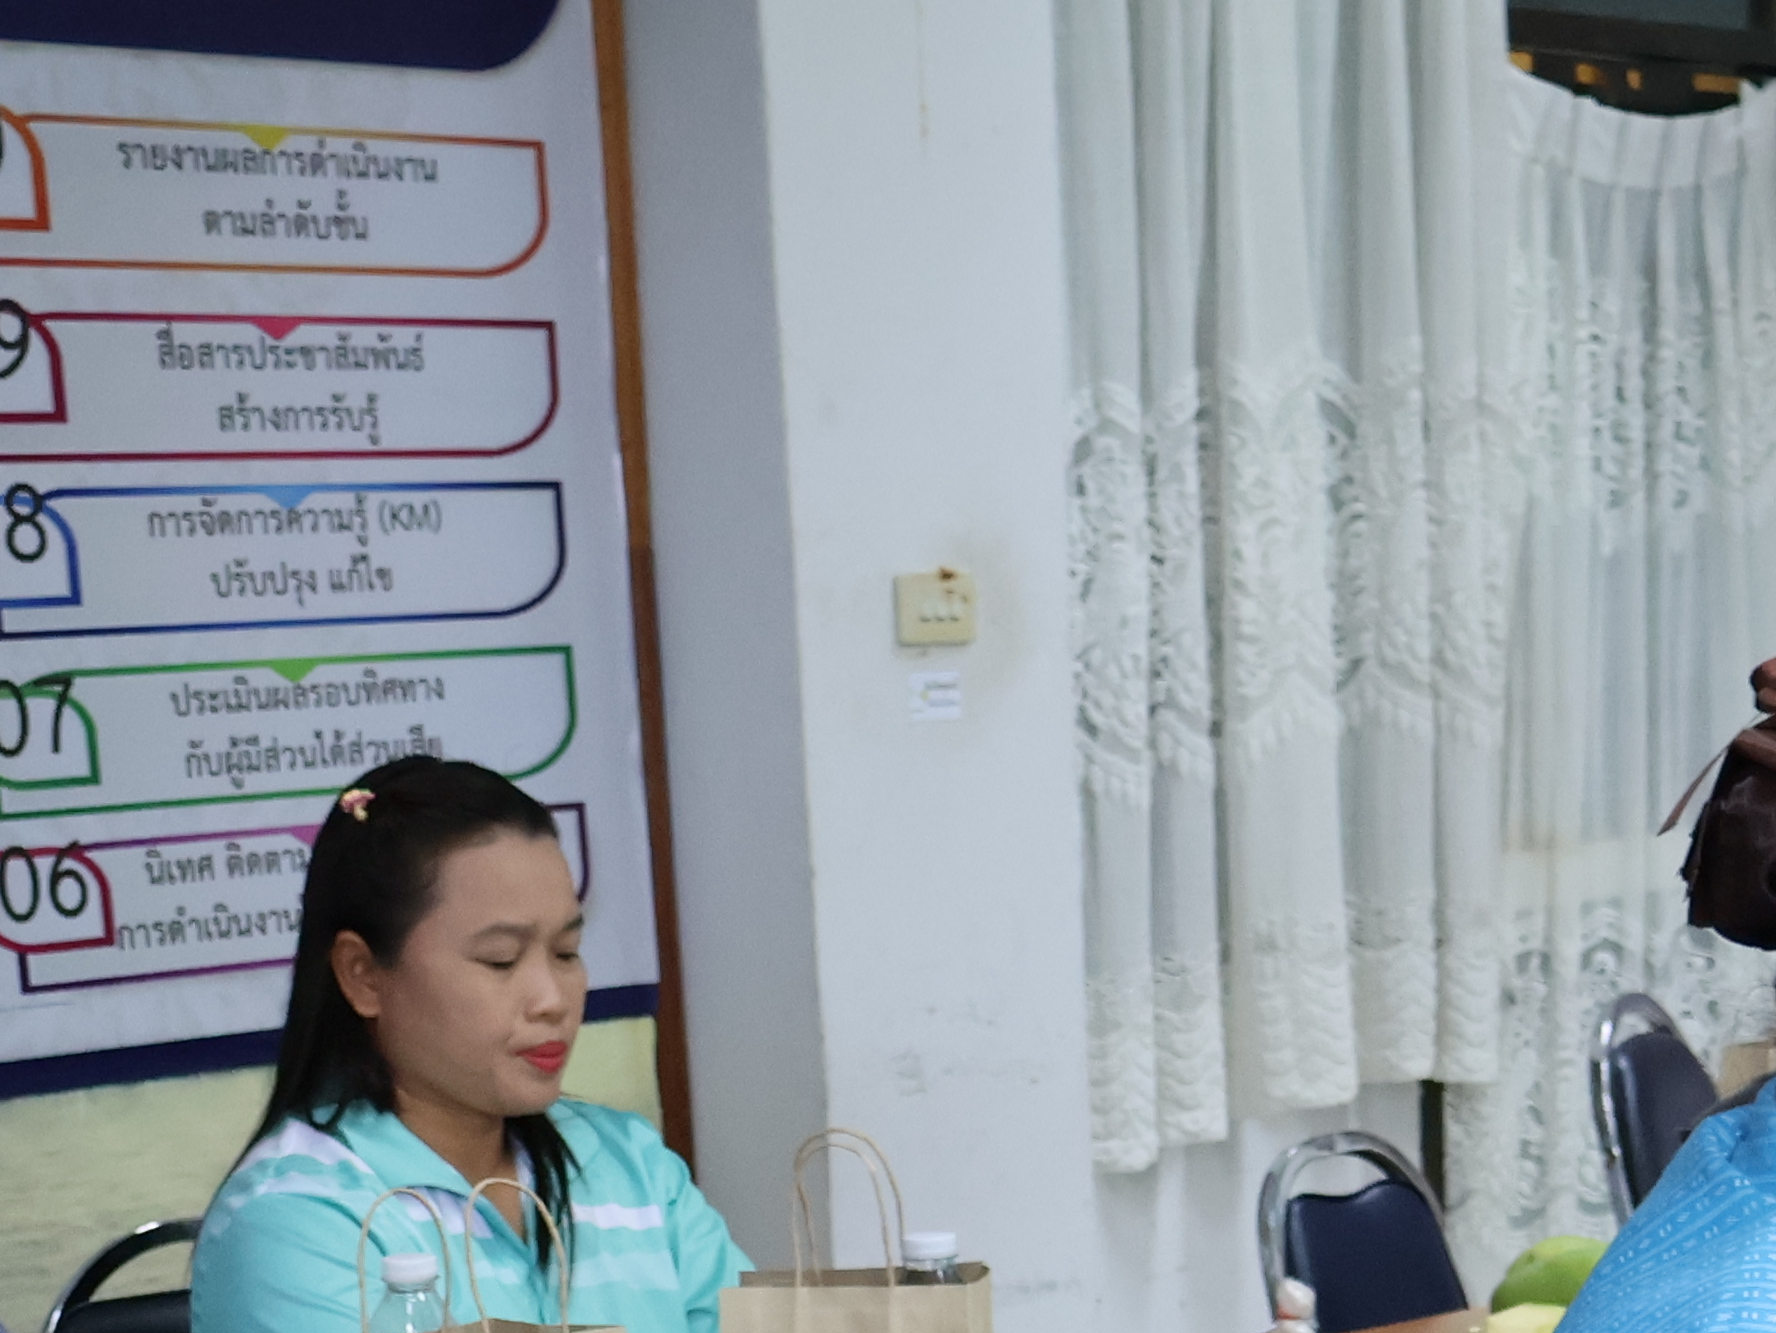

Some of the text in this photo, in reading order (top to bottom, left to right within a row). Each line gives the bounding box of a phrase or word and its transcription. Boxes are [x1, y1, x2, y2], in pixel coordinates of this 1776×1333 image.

[379, 499, 442, 535] (KM)
[210, 553, 393, 607] ปรับปรุง แก้ไข
